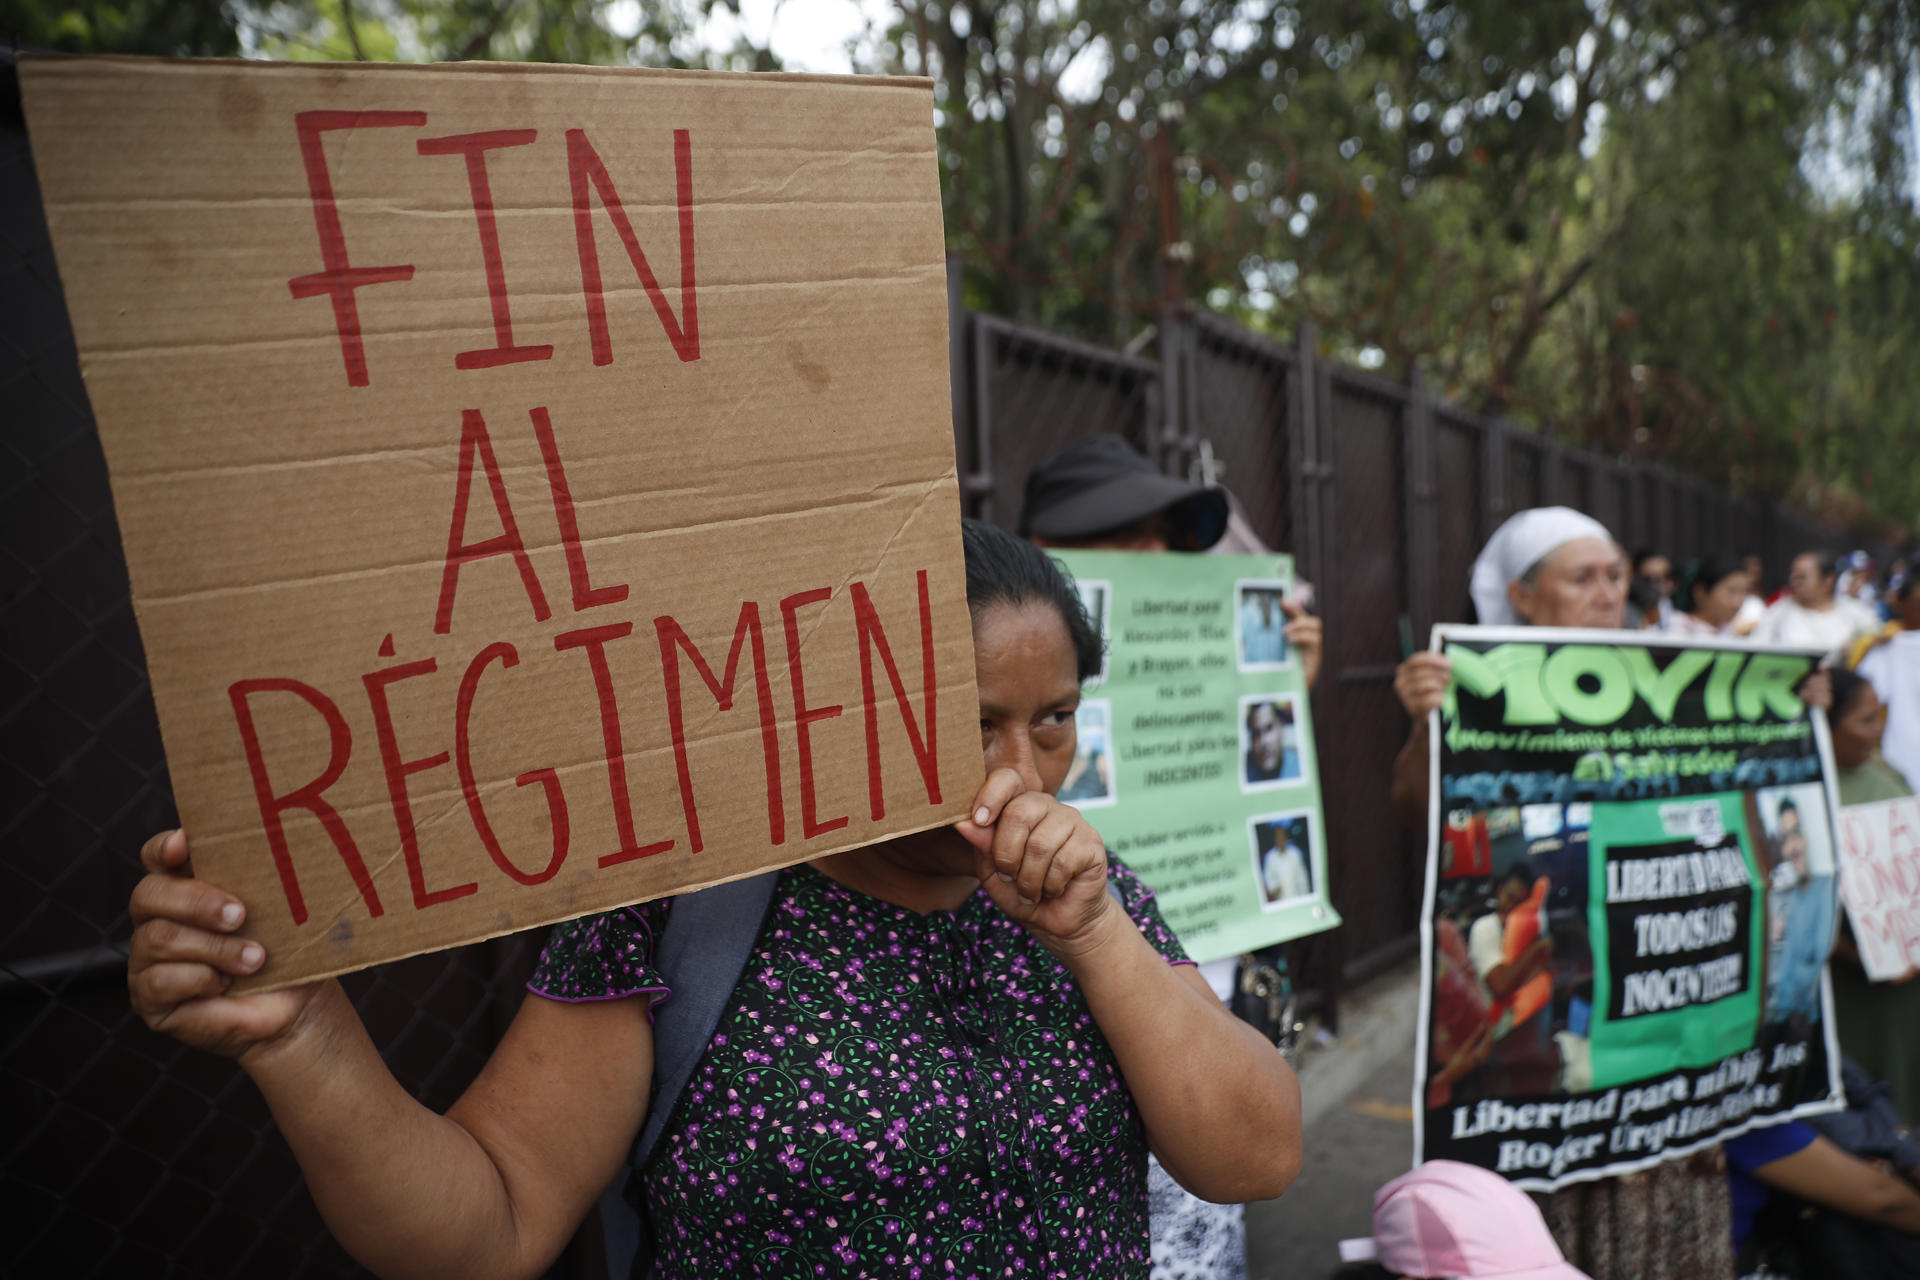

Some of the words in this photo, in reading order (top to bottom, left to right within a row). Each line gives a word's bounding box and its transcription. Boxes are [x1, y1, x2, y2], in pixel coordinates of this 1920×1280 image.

[288, 110, 701, 387] FIN
[434, 406, 629, 635] AL
[228, 569, 943, 925] RÉGIMEN
[1441, 643, 1812, 727] MOVIR
[1452, 1088, 1619, 1139] Libertad
